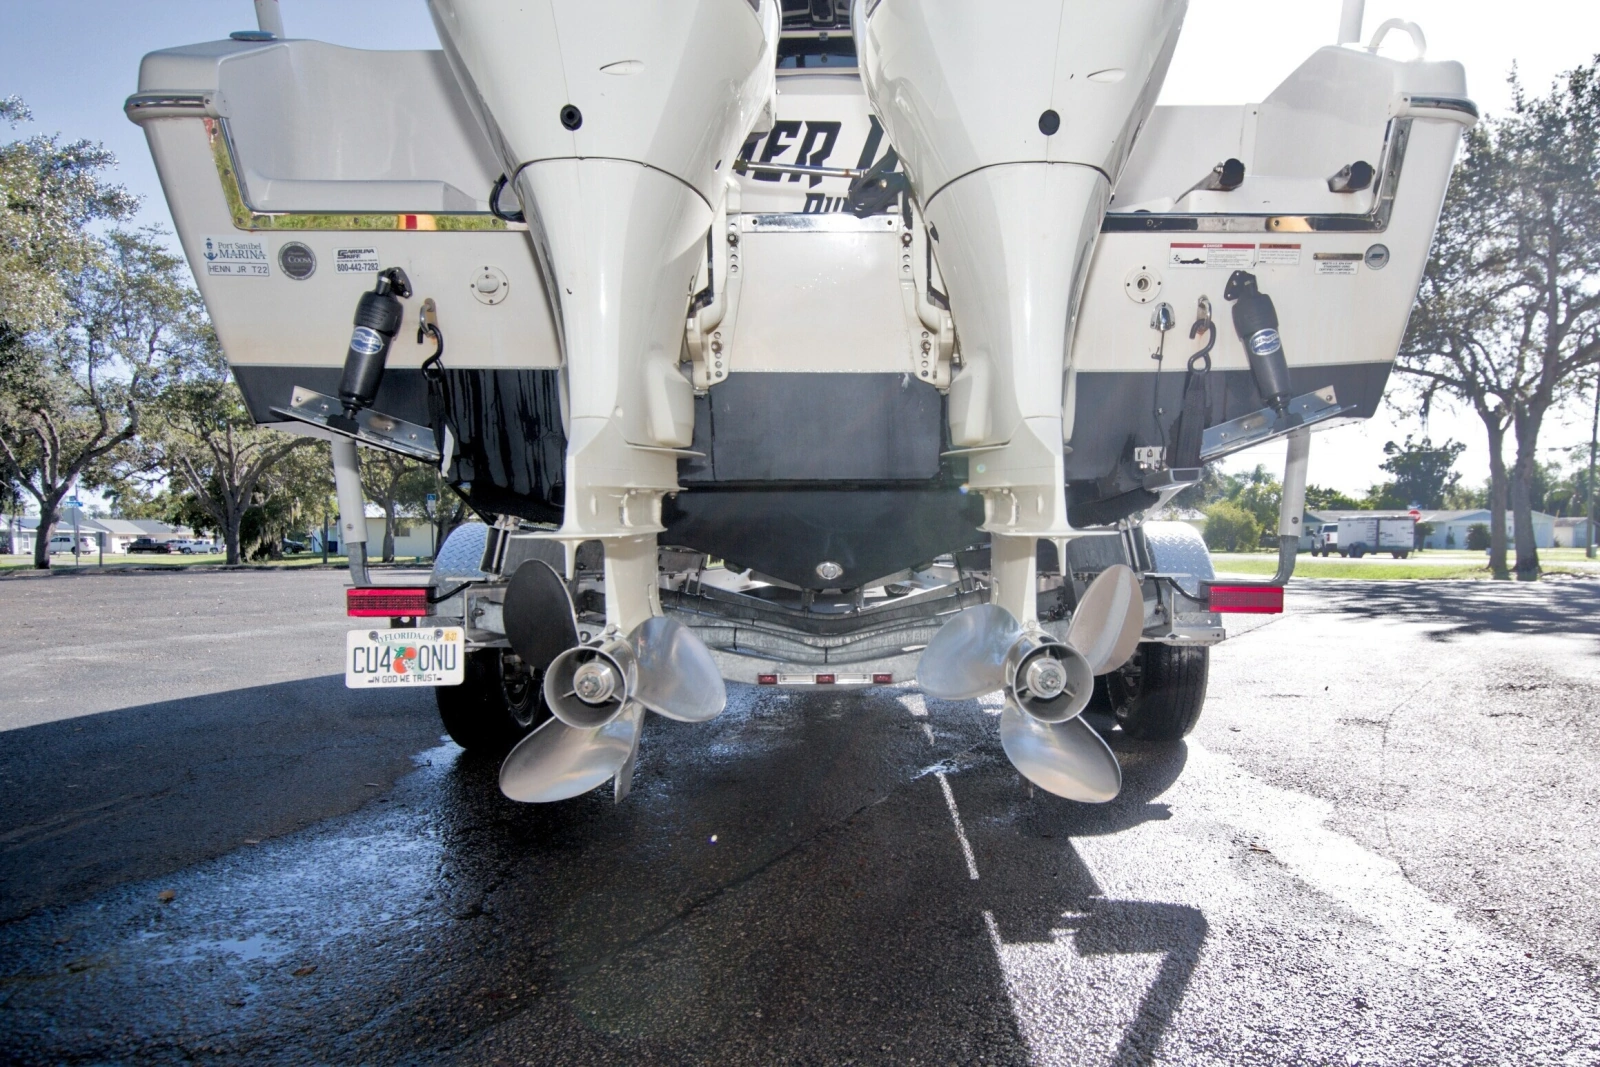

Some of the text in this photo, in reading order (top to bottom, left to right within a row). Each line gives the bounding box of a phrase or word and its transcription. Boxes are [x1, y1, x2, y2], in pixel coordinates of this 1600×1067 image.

[217, 242, 262, 250] Port Sanibel
[219, 249, 267, 260] MARINA
[209, 265, 268, 274] HENN JR T22
[336, 262, 380, 272] 800-442-7282
[353, 645, 392, 674] CU4
[382, 675, 398, 683] GOD
[400, 674, 411, 683] WE
[412, 673, 437, 682] TRUST
